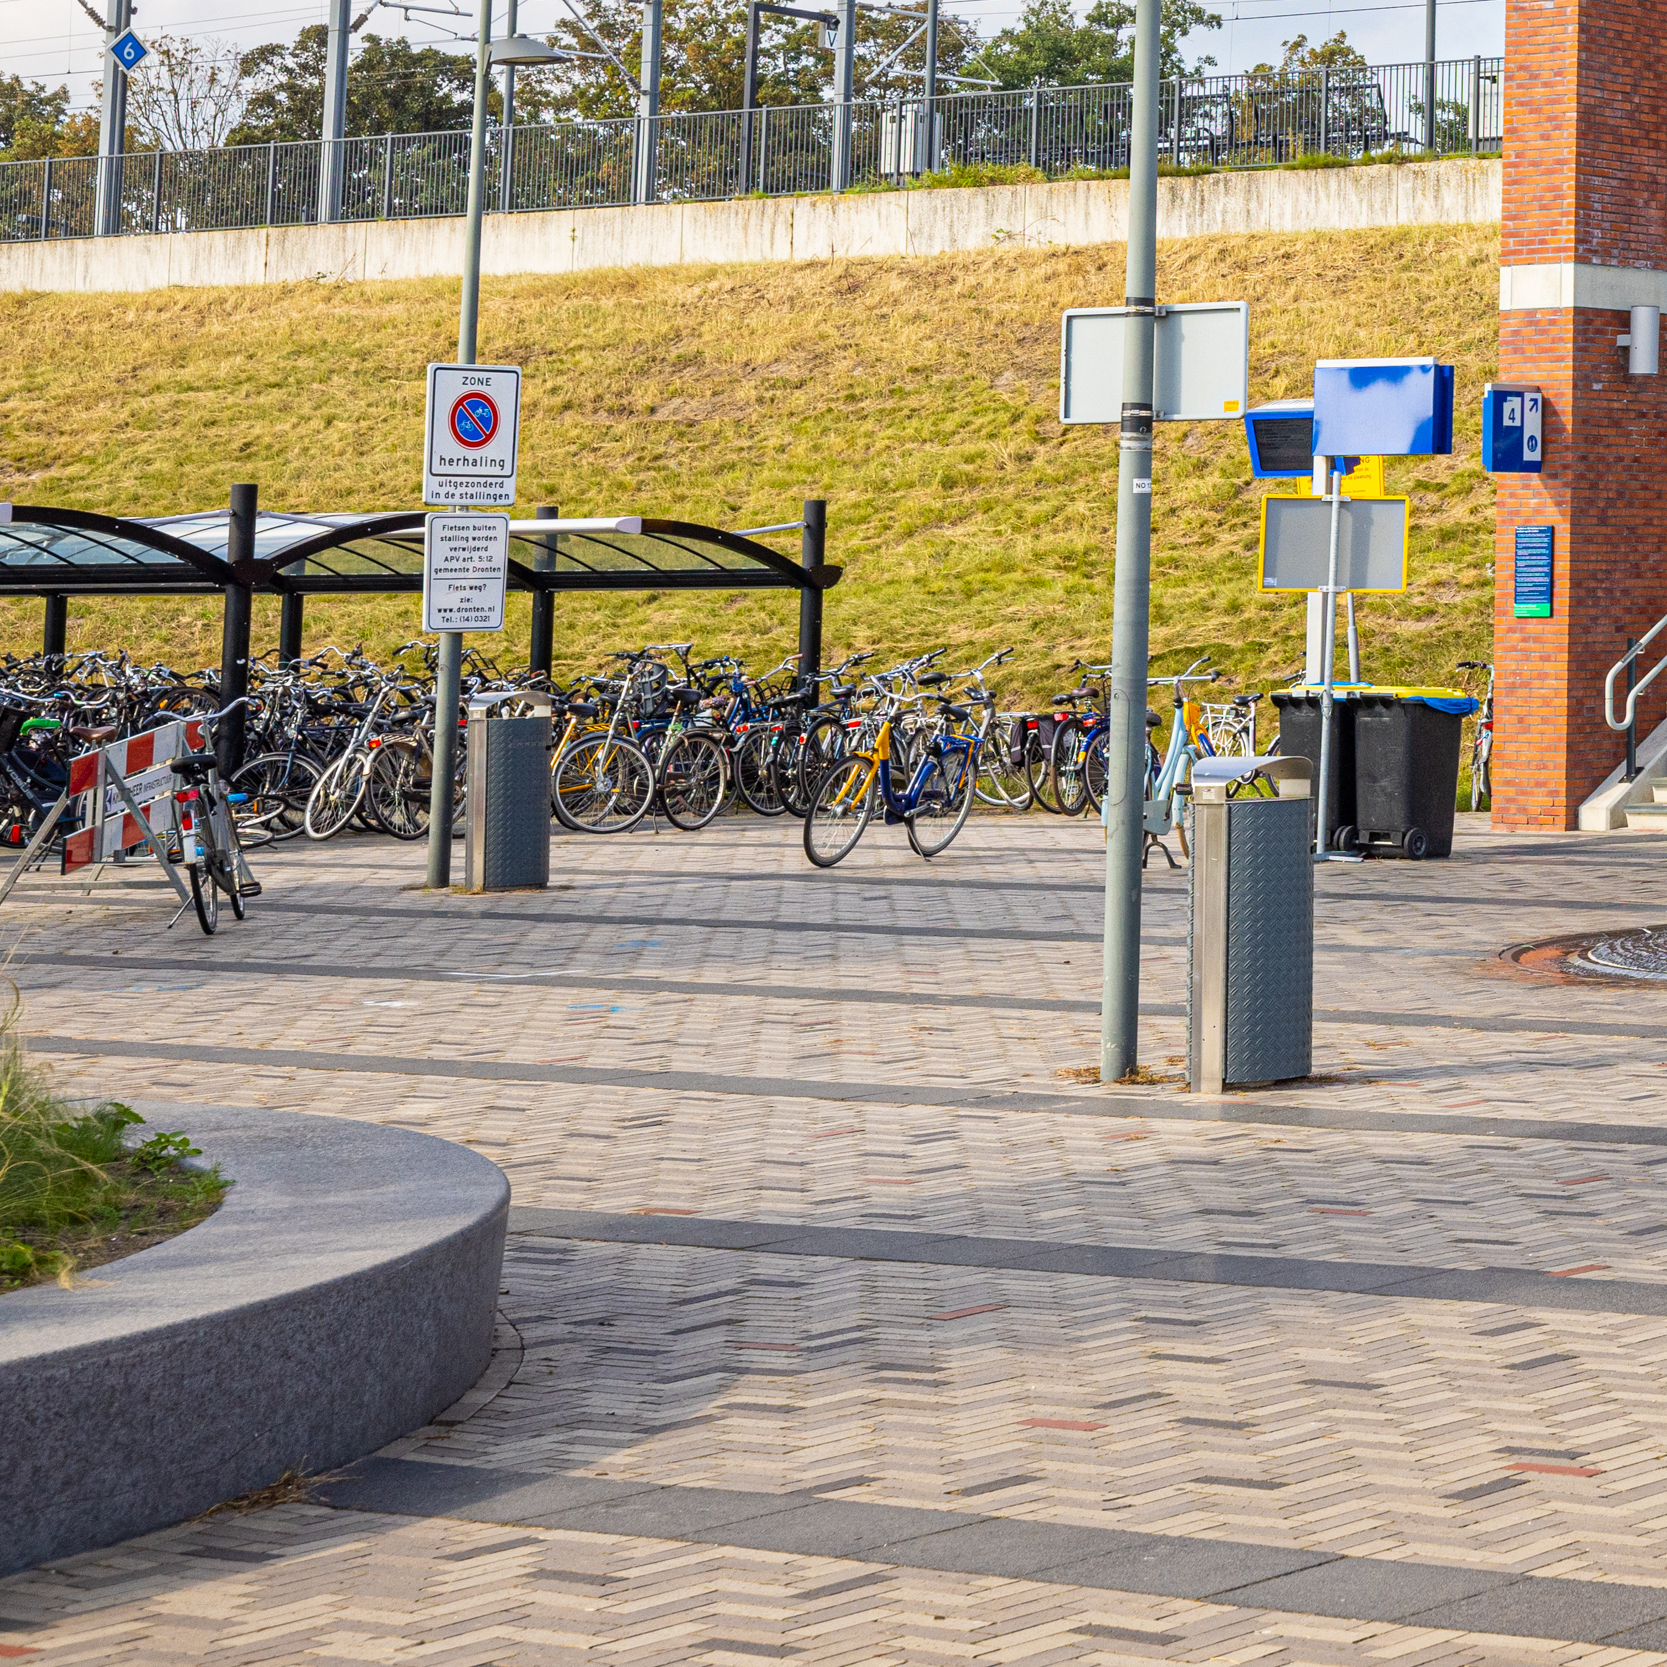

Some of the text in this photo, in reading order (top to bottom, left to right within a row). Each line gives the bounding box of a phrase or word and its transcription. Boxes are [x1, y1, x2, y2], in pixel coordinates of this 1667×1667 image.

[124, 42, 134, 60] 6
[462, 377, 492, 386] ZONE
[1508, 407, 1515, 423] 4
[439, 455, 505, 471] herhaling
[438, 480, 504, 489] uitgezonderd
[431, 490, 509, 502] in de stallingen
[440, 535, 469, 543] stalling
[449, 546, 488, 554] verwijderd
[469, 584, 487, 592] weg?
